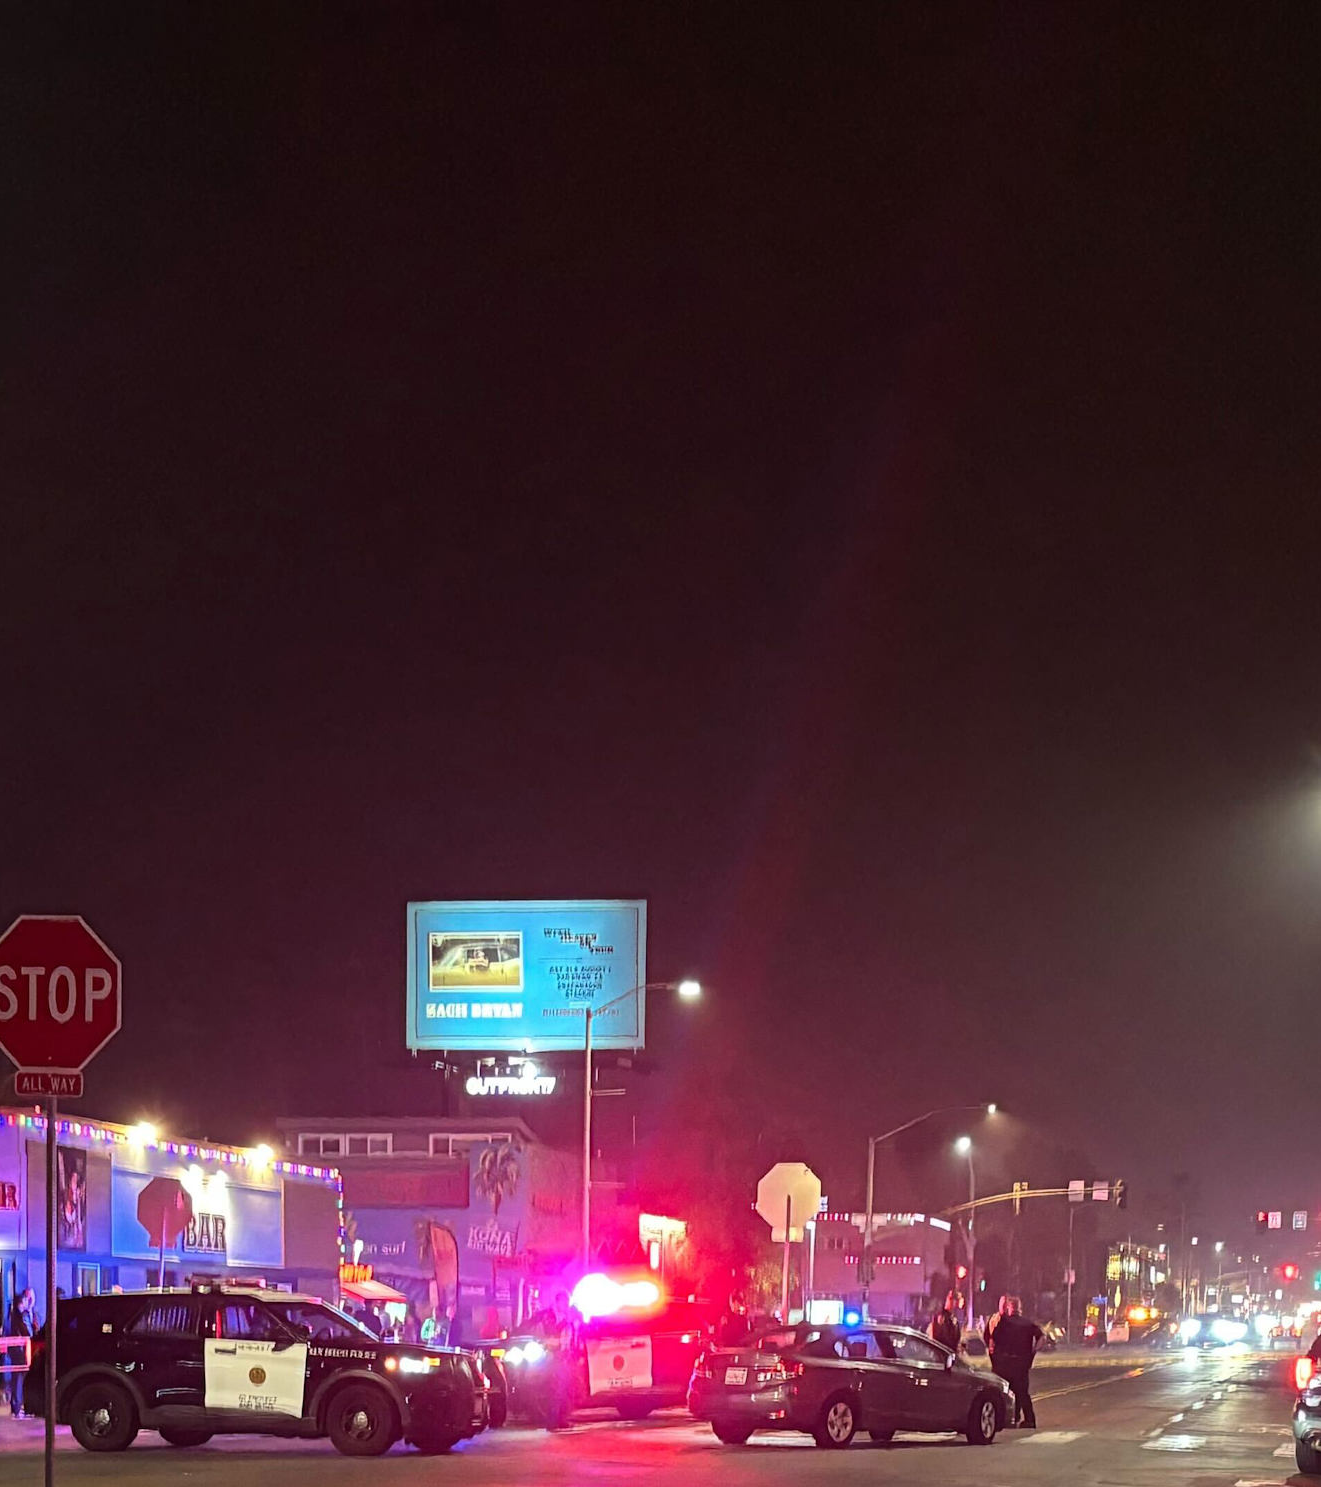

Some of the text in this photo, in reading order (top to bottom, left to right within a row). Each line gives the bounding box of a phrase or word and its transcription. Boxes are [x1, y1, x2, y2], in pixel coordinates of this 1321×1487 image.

[22, 1077, 76, 1091] ALL WAY
[183, 1212, 227, 1254] BAR
